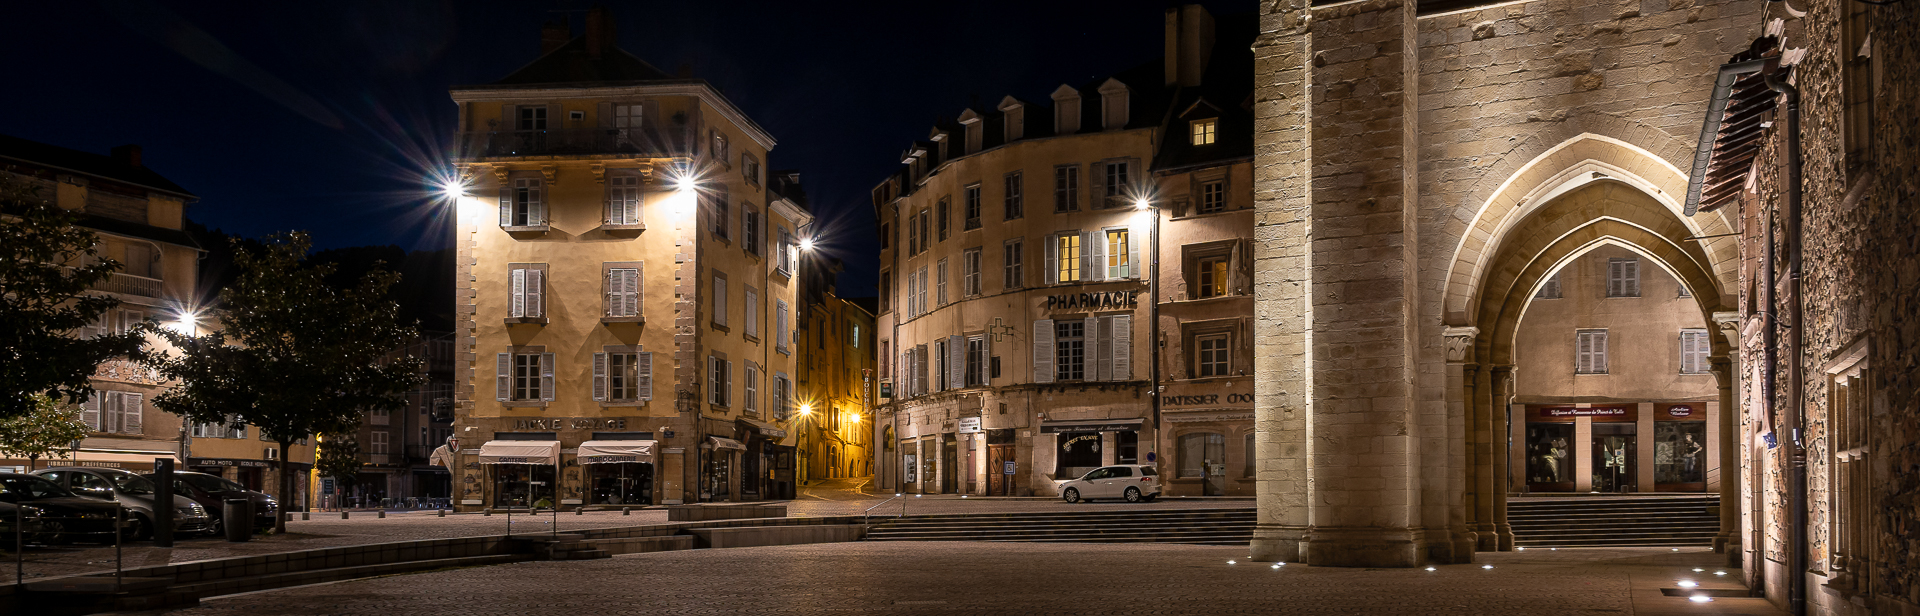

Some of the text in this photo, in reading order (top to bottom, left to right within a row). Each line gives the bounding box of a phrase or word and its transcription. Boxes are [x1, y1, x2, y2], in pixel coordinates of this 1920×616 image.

[1047, 289, 1138, 310] PHARMACIE
[1162, 394, 1219, 406] PATISSIER
[513, 419, 562, 430] JACKIE
[157, 460, 163, 470] P
